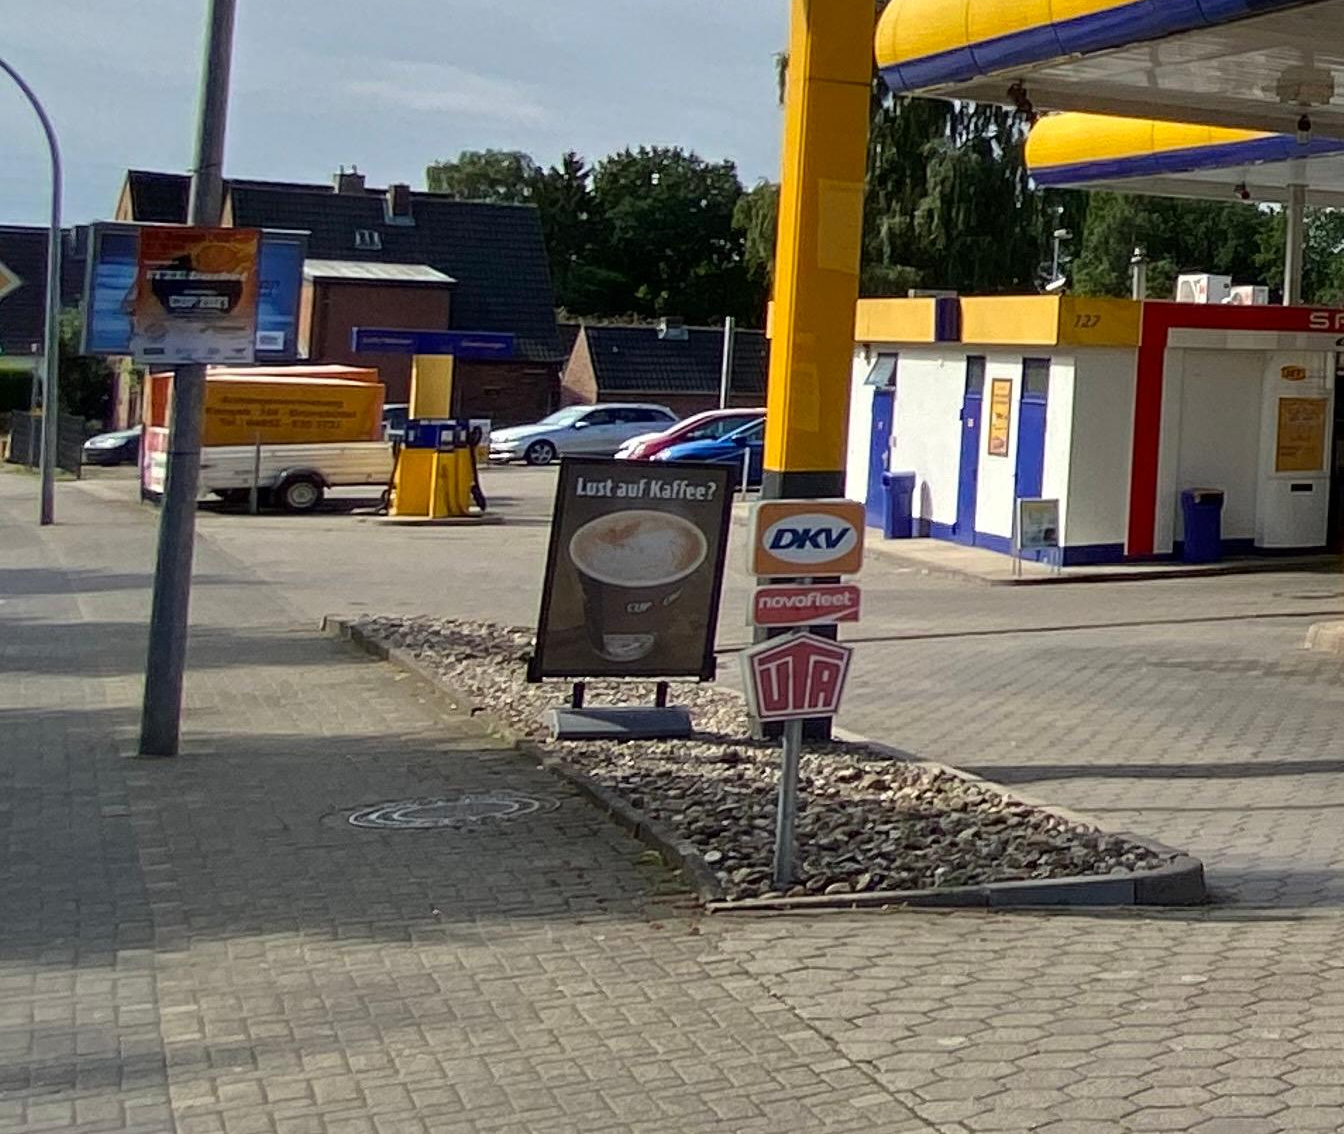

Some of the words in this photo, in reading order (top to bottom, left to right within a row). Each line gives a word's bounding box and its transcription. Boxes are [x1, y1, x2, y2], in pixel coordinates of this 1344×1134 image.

[576, 477, 612, 497] Lust
[616, 479, 648, 498] auf
[649, 479, 717, 500] Kaffee?
[769, 527, 851, 550] DKV
[758, 591, 852, 608] novofleet
[758, 636, 845, 712] UTA
